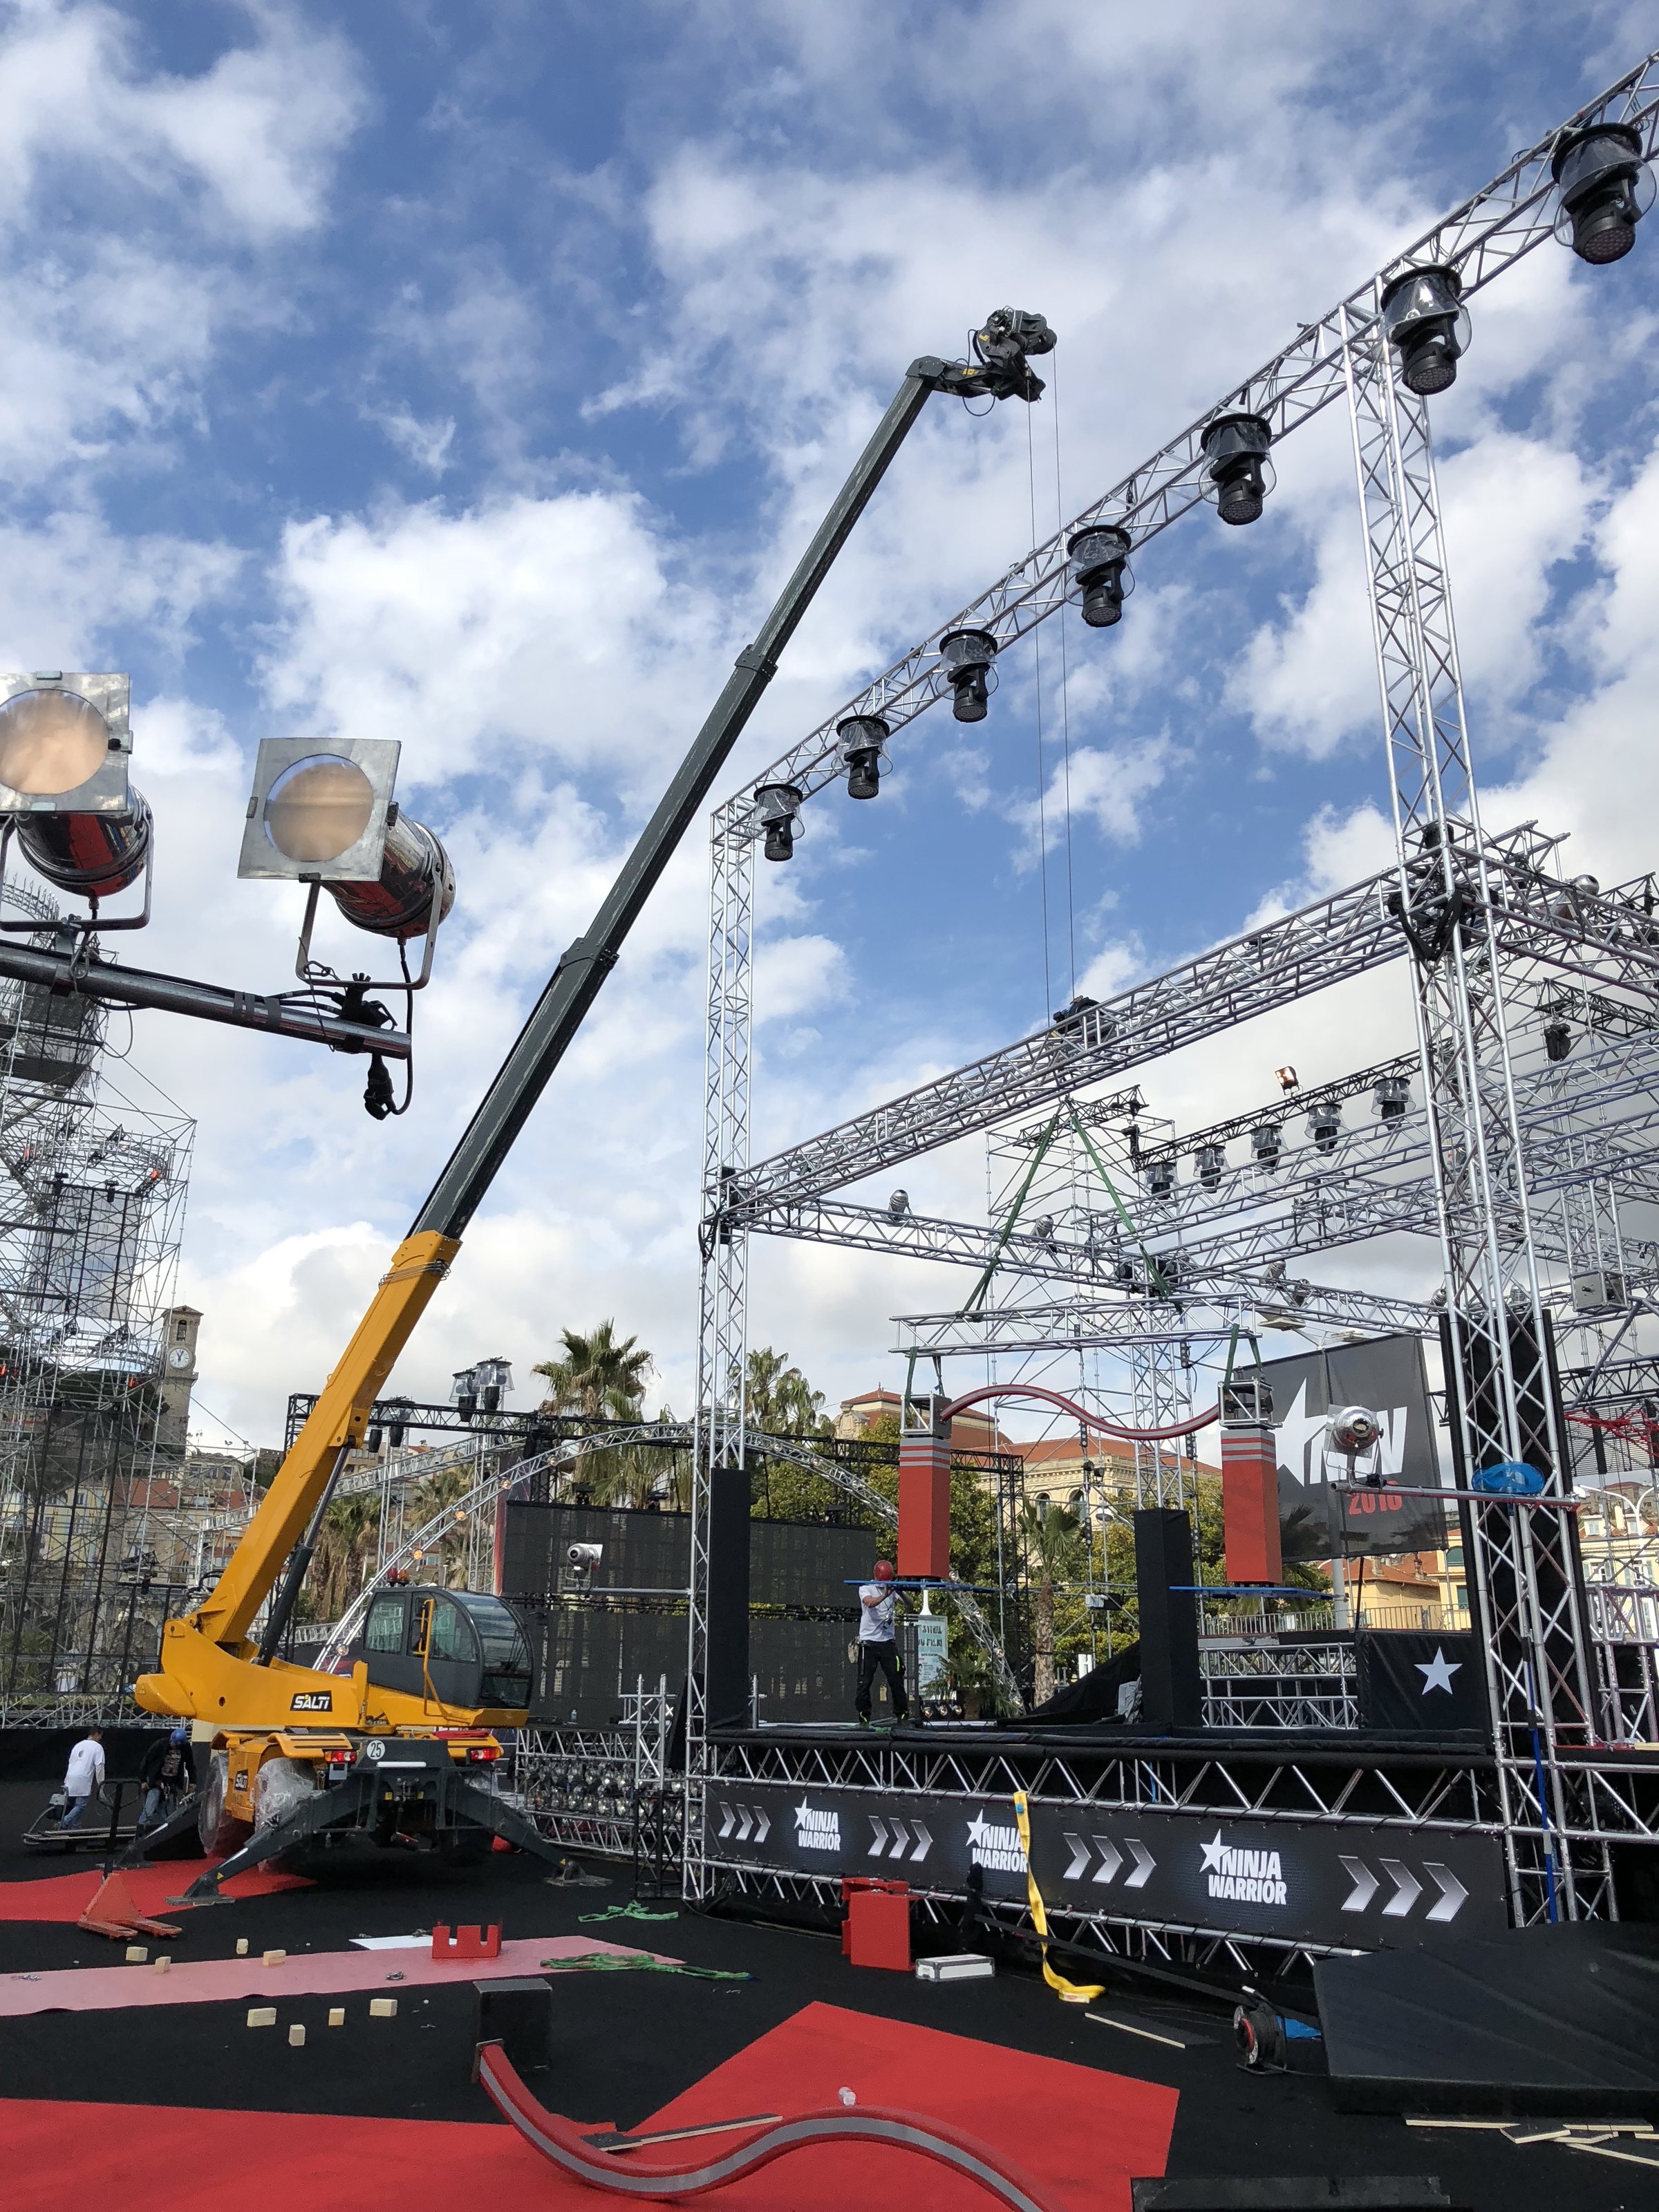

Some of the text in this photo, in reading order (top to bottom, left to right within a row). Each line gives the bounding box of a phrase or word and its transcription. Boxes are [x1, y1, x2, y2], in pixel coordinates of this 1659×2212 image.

[371, 1743, 382, 1758] 25
[806, 1810, 838, 1833] NINJA
[798, 1830, 841, 1851] WARRIOR
[982, 1826, 1025, 1852] NINJA
[972, 1847, 1028, 1873] WARRIOR
[1221, 1848, 1282, 1880] NINJA
[1208, 1874, 1287, 1905] WARRIOR
